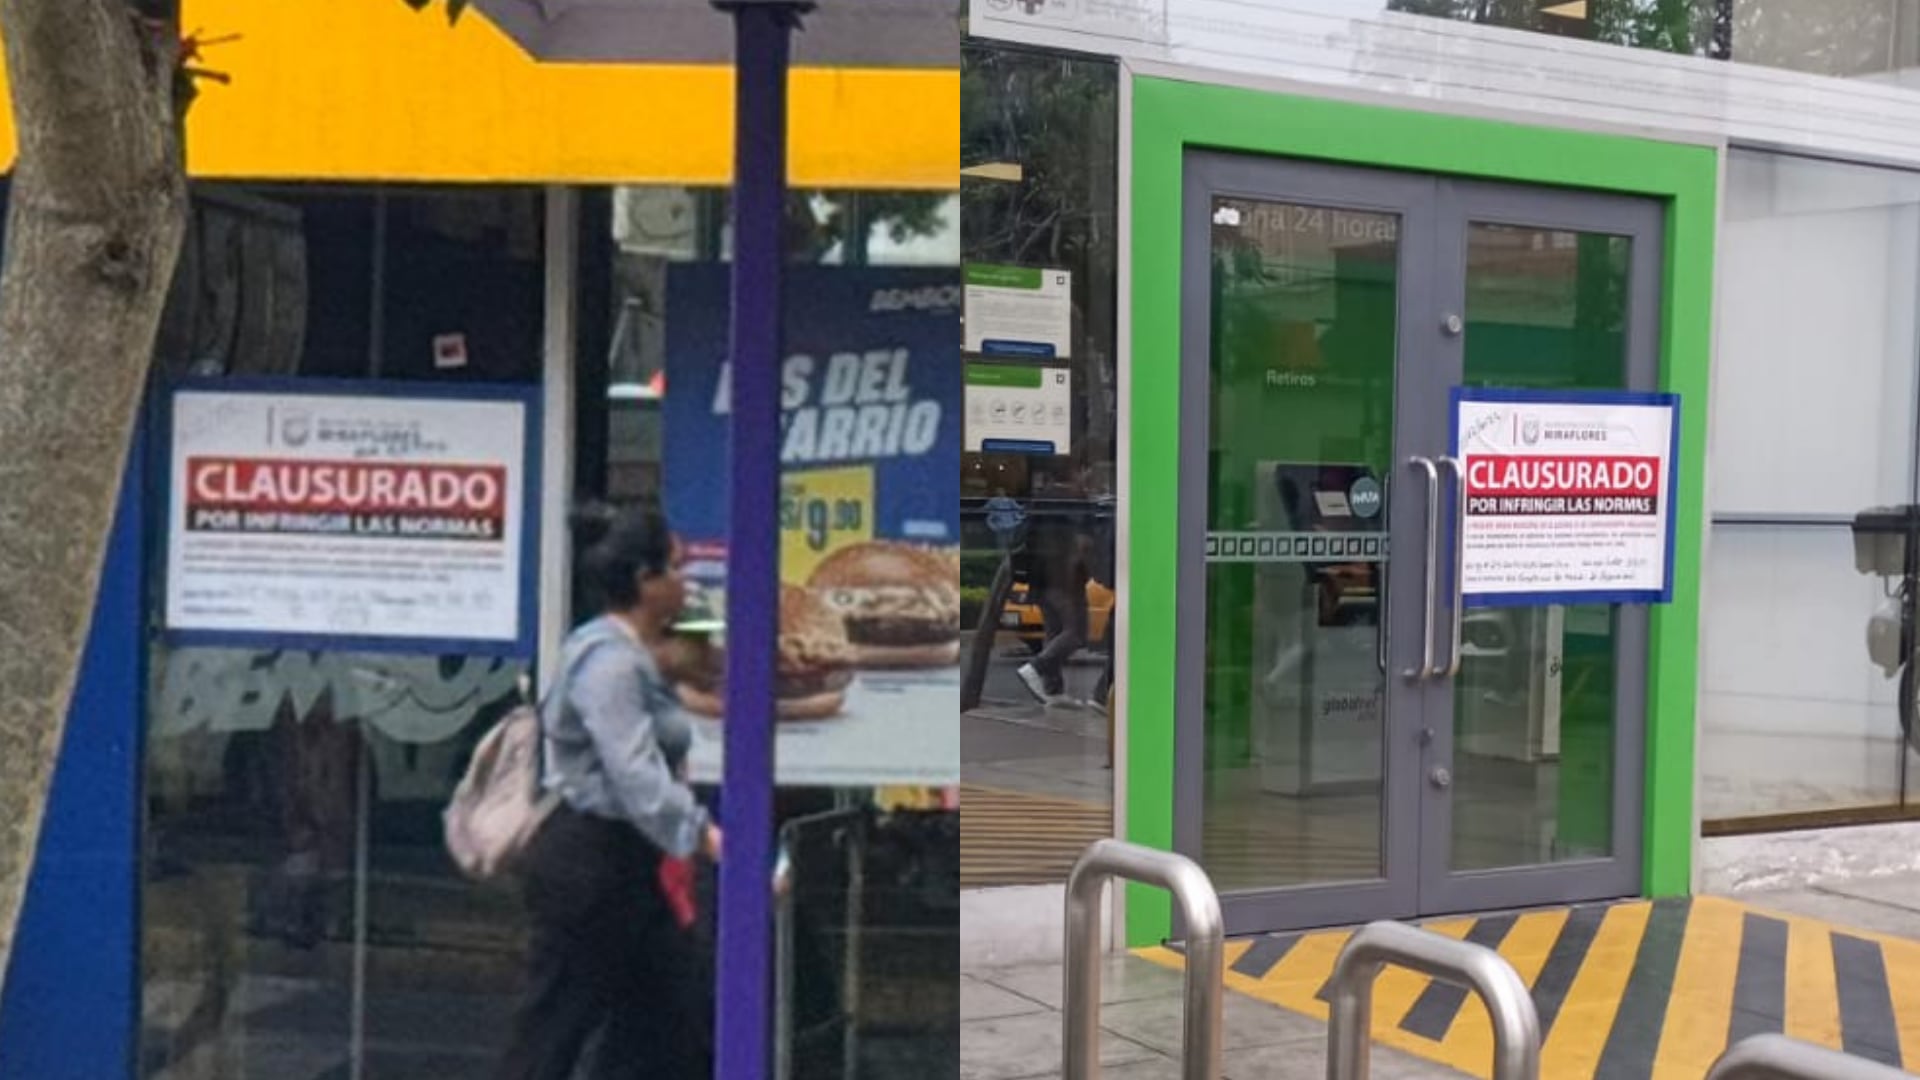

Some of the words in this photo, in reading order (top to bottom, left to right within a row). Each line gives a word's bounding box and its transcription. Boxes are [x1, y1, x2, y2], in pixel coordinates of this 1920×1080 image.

[1295, 205, 1323, 233] 24
[821, 349, 910, 405] DEL
[1266, 369, 1316, 387] Retiros
[780, 400, 941, 462] ARRIO
[1543, 429, 1607, 441] MIRAFLORES
[196, 463, 498, 510] CLAUSURADO
[1469, 460, 1653, 490] CLAUSURADO
[1470, 497, 1497, 513] POR
[1499, 497, 1565, 513] INFRINGIR
[1568, 497, 1592, 513] LAS
[1594, 497, 1650, 513] NORMAS
[195, 509, 238, 529] POR
[243, 511, 350, 532] INFRINGIR
[356, 515, 395, 534] LAS
[400, 516, 494, 537] NORMAS
